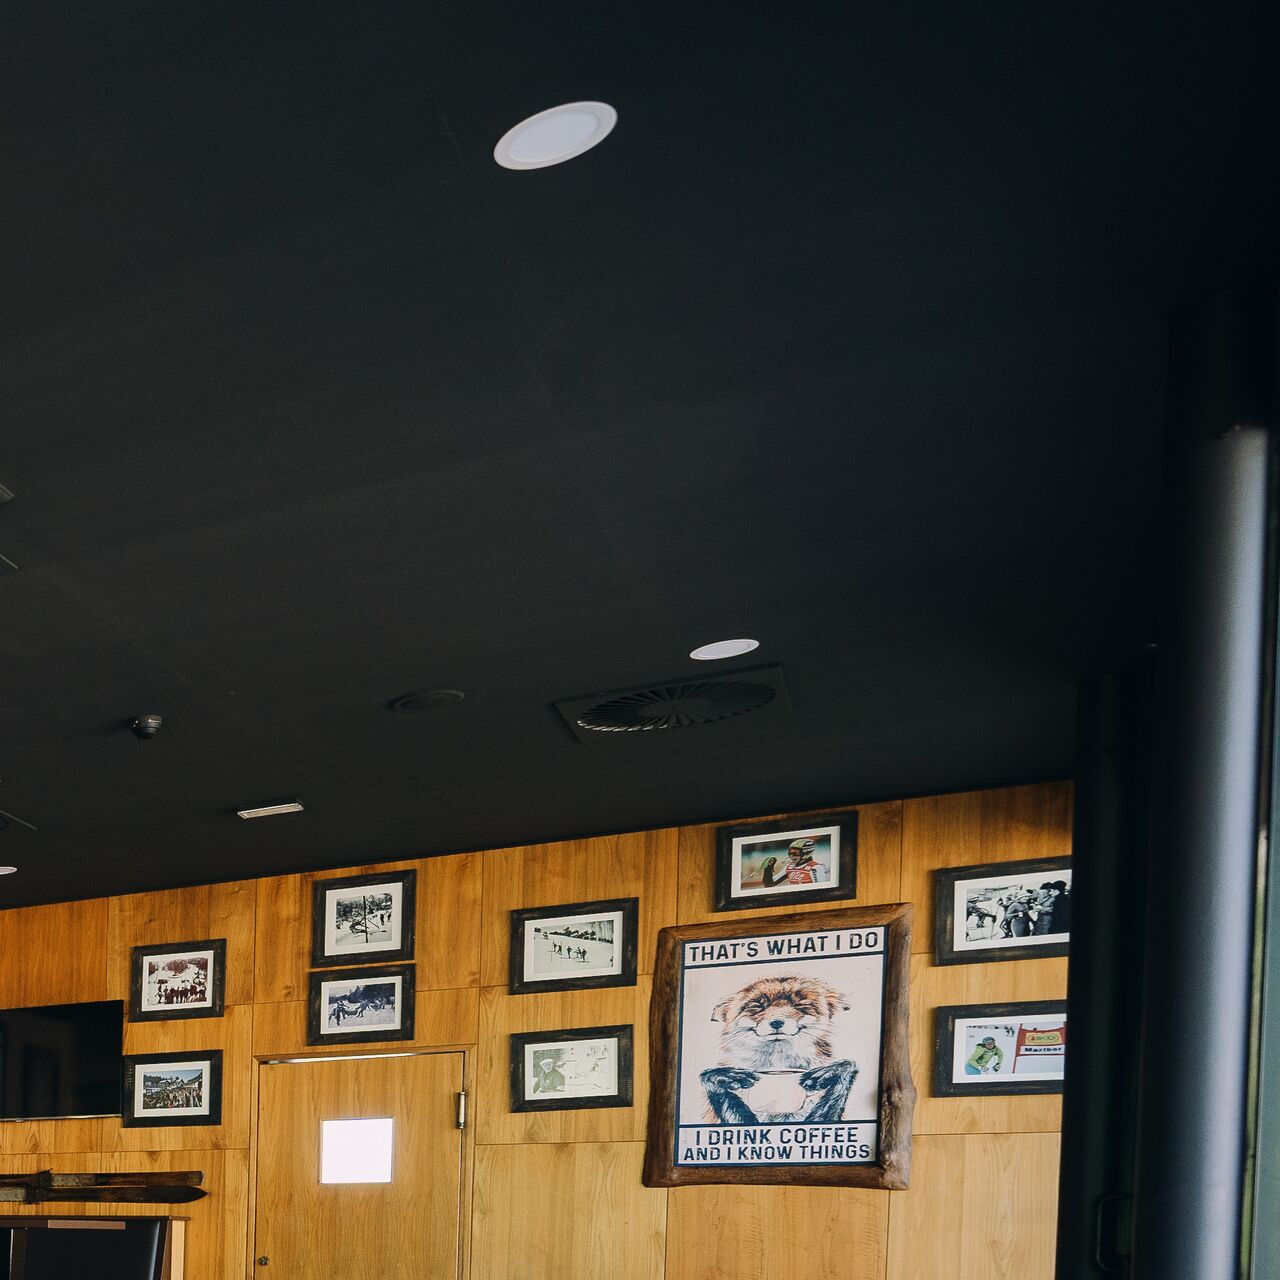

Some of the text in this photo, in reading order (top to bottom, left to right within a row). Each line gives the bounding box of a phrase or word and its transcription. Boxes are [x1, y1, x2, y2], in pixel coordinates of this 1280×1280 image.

[689, 931, 879, 962] THAT'S WHAT I DO
[696, 1127, 859, 1146] I DRINK COFFEE
[684, 1144, 871, 1161] AND I KNOW THINGS
